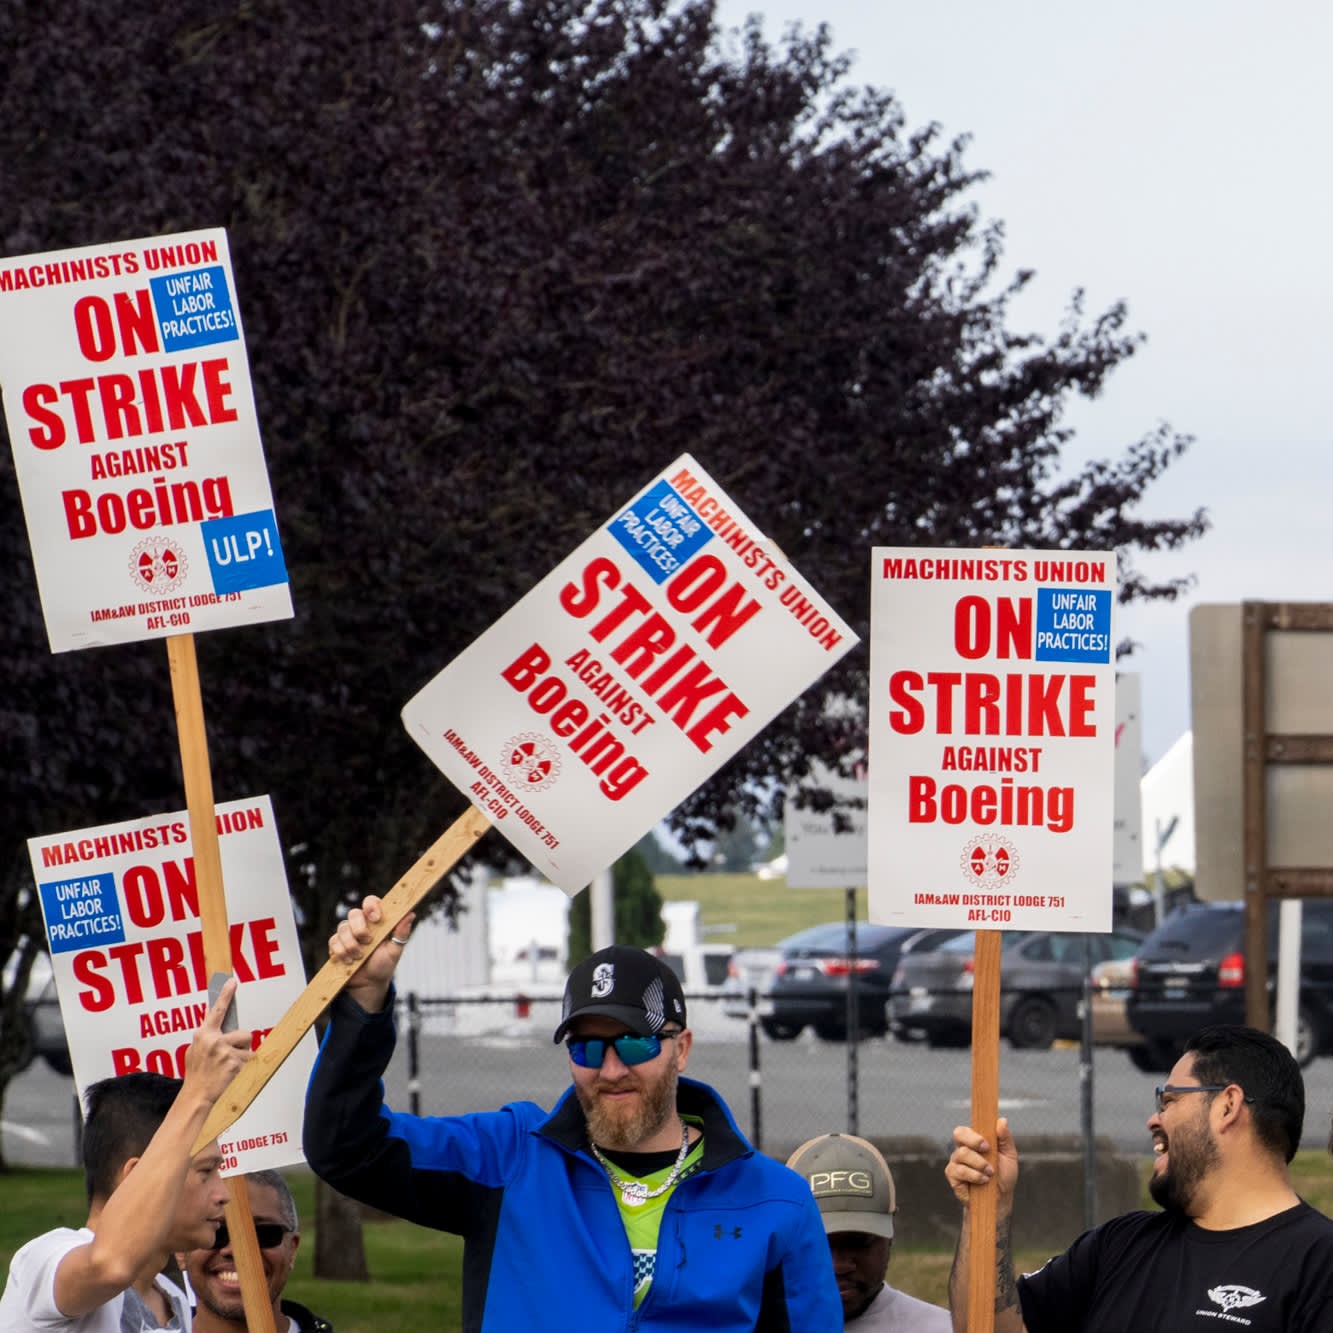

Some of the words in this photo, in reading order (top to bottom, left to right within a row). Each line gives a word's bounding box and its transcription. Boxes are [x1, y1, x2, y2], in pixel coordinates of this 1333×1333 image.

[0, 252, 140, 292] MACHINISTS
[144, 240, 218, 271] UNION
[167, 273, 212, 296] UNFAIR
[173, 293, 215, 315] LABOR
[74, 289, 160, 362] ON
[163, 310, 233, 338] PRACTICES!
[23, 358, 238, 451] STRIKE
[91, 441, 188, 480] AGAINST
[62, 476, 234, 540] Boeing
[660, 494, 700, 537] UNFAIR
[619, 511, 678, 573] PRACTICES!
[645, 509, 683, 548] LABOR
[212, 531, 274, 566] ULP!
[671, 469, 785, 591] MACHINISTS
[780, 585, 842, 651] UNION
[883, 558, 1028, 582] MACHINISTS
[1034, 561, 1105, 583] UNION
[91, 604, 136, 622] IAM&AW
[138, 597, 186, 615] DISTRICT
[189, 592, 222, 606] LODGE
[147, 612, 190, 630] AFL-CIO
[666, 554, 762, 650] ON
[1053, 594, 1096, 610] UNFAIR
[1054, 614, 1093, 629] LABOR
[954, 595, 1033, 660] ON
[1038, 632, 1107, 650] PRACTICES!
[559, 557, 750, 754] STRIKE
[565, 648, 655, 735] AGAINST
[889, 670, 1097, 738] STRIKE
[501, 643, 649, 801] Boeing
[942, 746, 1043, 773] AGAINST
[443, 729, 483, 769] IAM&AW
[478, 766, 520, 808] DISTRICT
[515, 805, 546, 836] LODGE
[541, 831, 560, 850] 751
[470, 781, 509, 820] AFL-CIO
[909, 775, 1074, 833] Boeing
[42, 822, 187, 867] MACHINISTS
[215, 808, 264, 836] NION
[56, 880, 101, 901] UNFAIR
[62, 899, 103, 919] LABOR
[122, 857, 200, 928] ON
[914, 893, 960, 905] IAM&AW
[962, 894, 1011, 907] DISTRICT
[1013, 895, 1046, 908] LODGE
[1048, 896, 1065, 908] 751
[50, 915, 120, 940] PRACTICES!
[968, 909, 1011, 922] AFL-CIO
[237, 1136, 269, 1152] LODGE
[270, 1131, 288, 1145] 751
[811, 1171, 870, 1192] PFG
[1218, 1312, 1252, 1326] STEWARD
